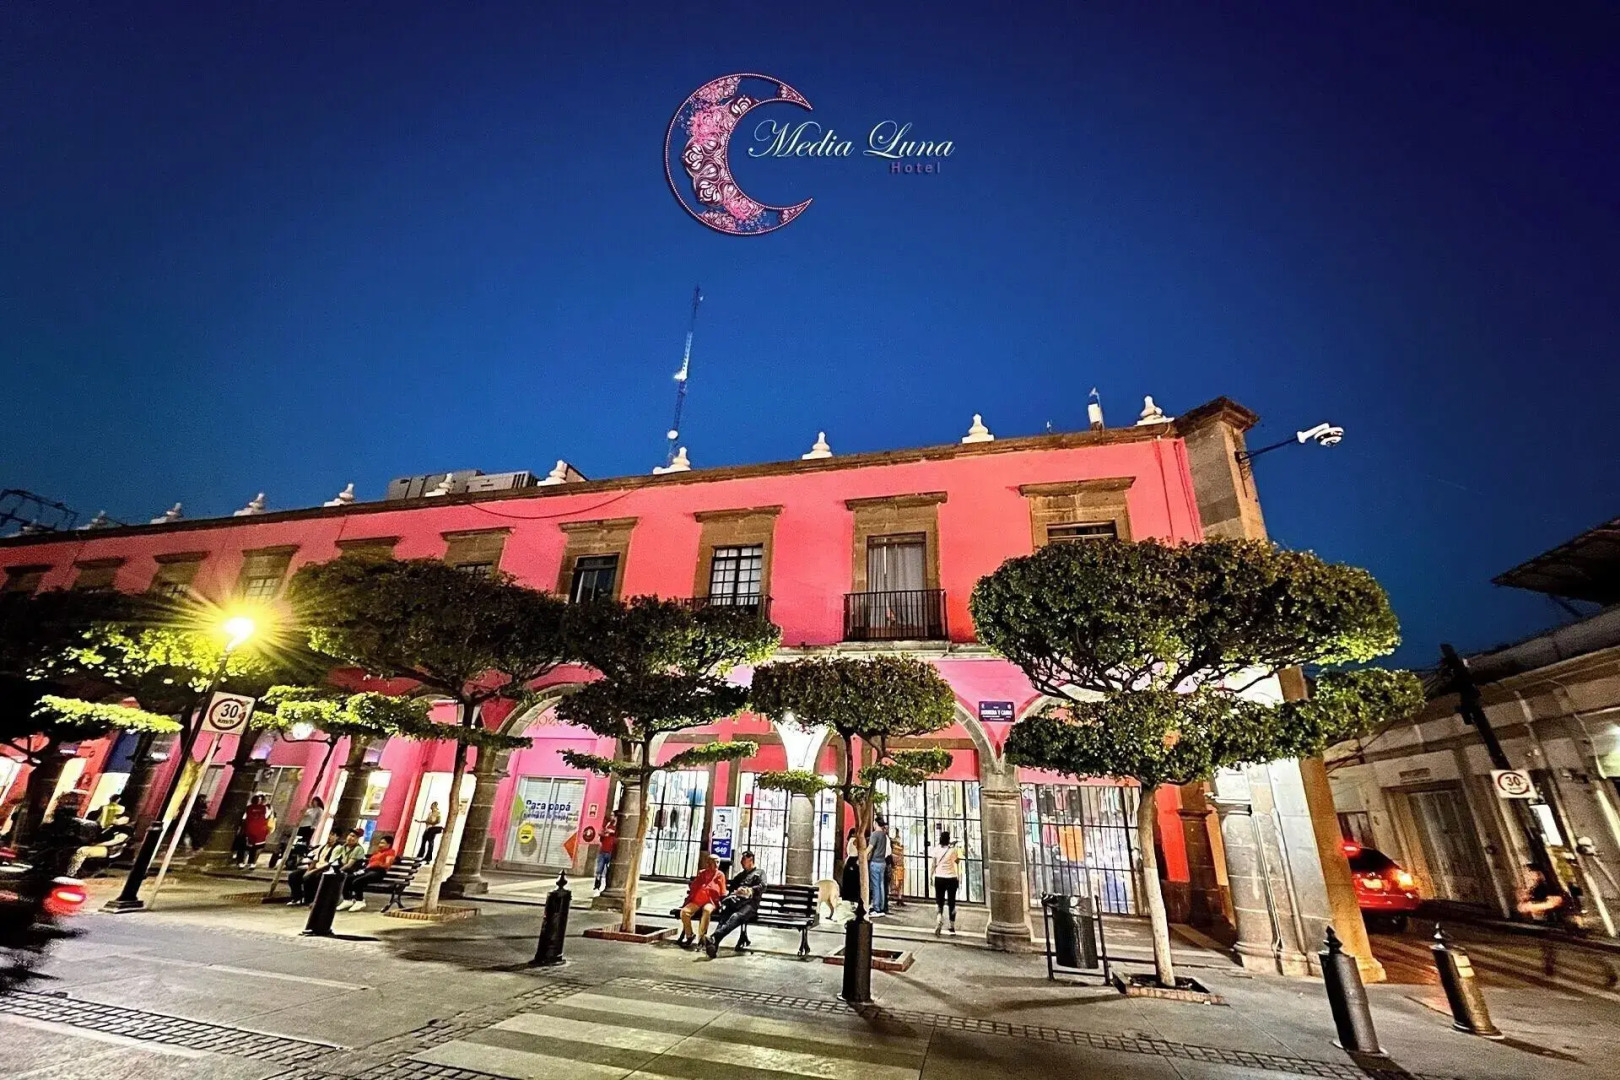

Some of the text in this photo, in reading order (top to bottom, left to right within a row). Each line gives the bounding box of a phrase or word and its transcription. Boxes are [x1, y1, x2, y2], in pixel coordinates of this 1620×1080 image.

[220, 704, 238, 718] 30
[1504, 776, 1521, 787] 30
[525, 799, 571, 814] Para papá
